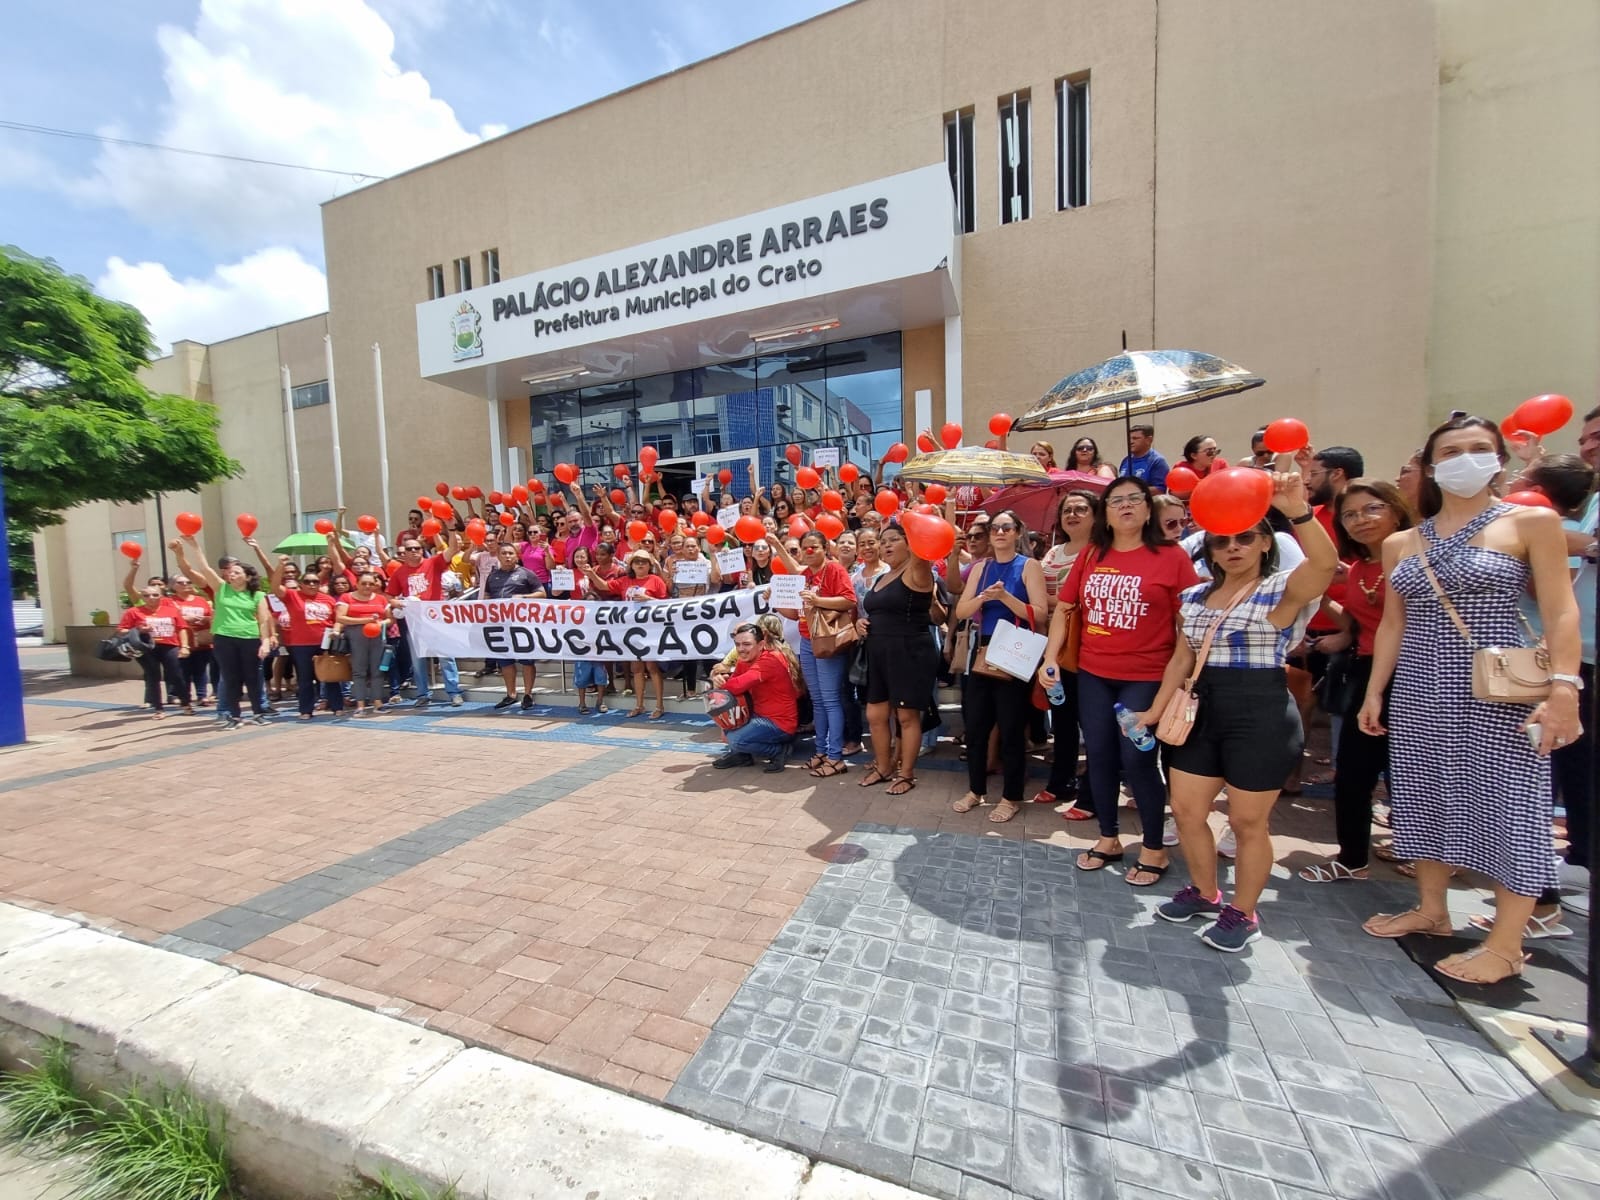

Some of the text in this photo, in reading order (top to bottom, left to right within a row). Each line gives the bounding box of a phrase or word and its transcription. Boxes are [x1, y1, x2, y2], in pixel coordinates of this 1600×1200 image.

[492, 198, 889, 321] PALÁCIO ALEXANDRE ARRAES
[534, 258, 823, 337] Prefeitura Municipal do Crato
[1083, 584, 1143, 602] PÚBLICO:
[1086, 574, 1142, 588] SERVIÇO
[441, 602, 586, 625] SINDSMCRATO
[595, 606, 628, 625] EM
[634, 594, 740, 624] DEFESA
[753, 590, 777, 615] D
[1087, 609, 1106, 625] QUE
[1108, 613, 1138, 630] FAZ!
[1094, 598, 1103, 611] A
[1106, 599, 1150, 616] GENTE
[483, 622, 719, 661] EDUCAÇÃO
